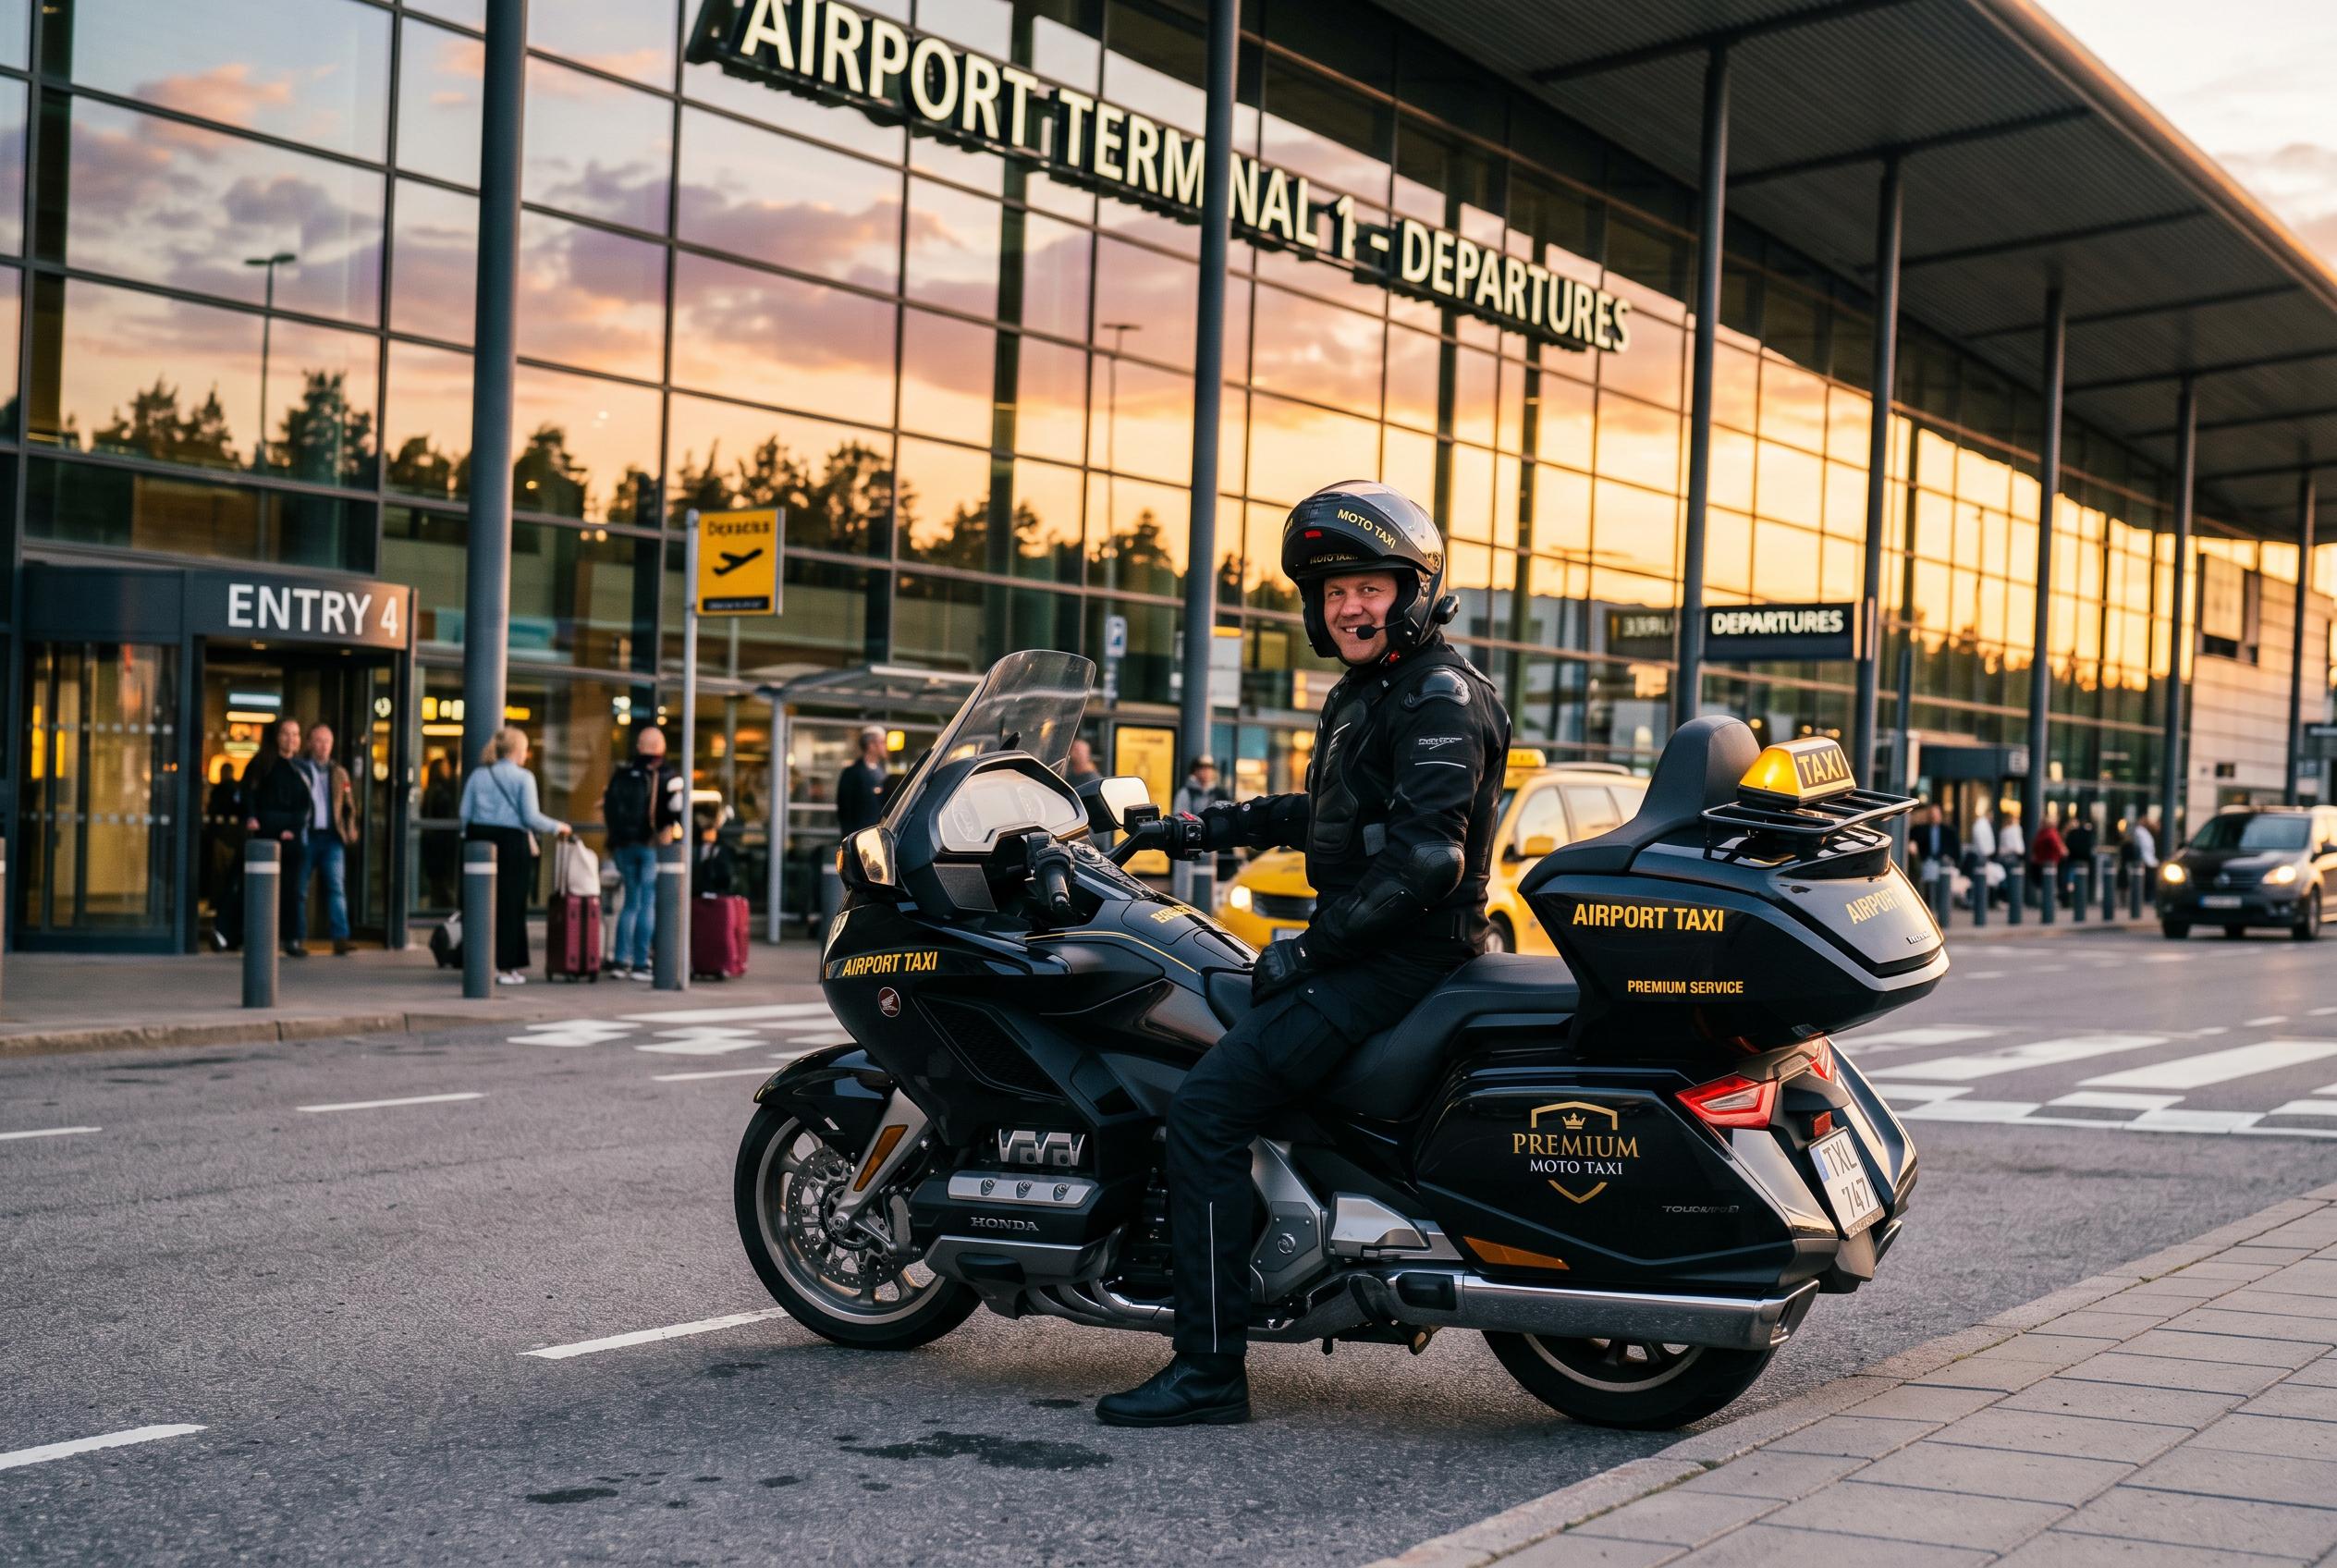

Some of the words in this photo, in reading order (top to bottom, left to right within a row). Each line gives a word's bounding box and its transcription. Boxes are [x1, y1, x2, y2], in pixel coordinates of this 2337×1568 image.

[740, 0, 1038, 147] AIRPORT
[1058, 89, 1319, 248] TERMNAL
[1337, 194, 1356, 261] 1
[1401, 218, 1632, 354] DEPARTURES
[1337, 509, 1374, 532] MOTO
[1375, 525, 1397, 549] TAXI
[228, 583, 373, 635] ENTRY
[380, 596, 398, 638] 4
[1711, 610, 1844, 635] DEPARTURES
[1797, 749, 1845, 785] TAXI
[1572, 903, 1669, 929] AIRPORT
[1673, 908, 1724, 932] TAXI
[842, 953, 901, 976] AIRPORT
[904, 951, 938, 972] TAXI
[1627, 980, 1686, 994] PREMIUM
[1690, 981, 1744, 994] SERVICE
[1511, 1133, 1641, 1158] PREMIUM
[1822, 1139, 1857, 1177] TXL
[1530, 1158, 1580, 1174] MOTO
[1585, 1161, 1623, 1175] TAXI
[1841, 1177, 1870, 1219] 747
[970, 1217, 1040, 1231] HONDA
